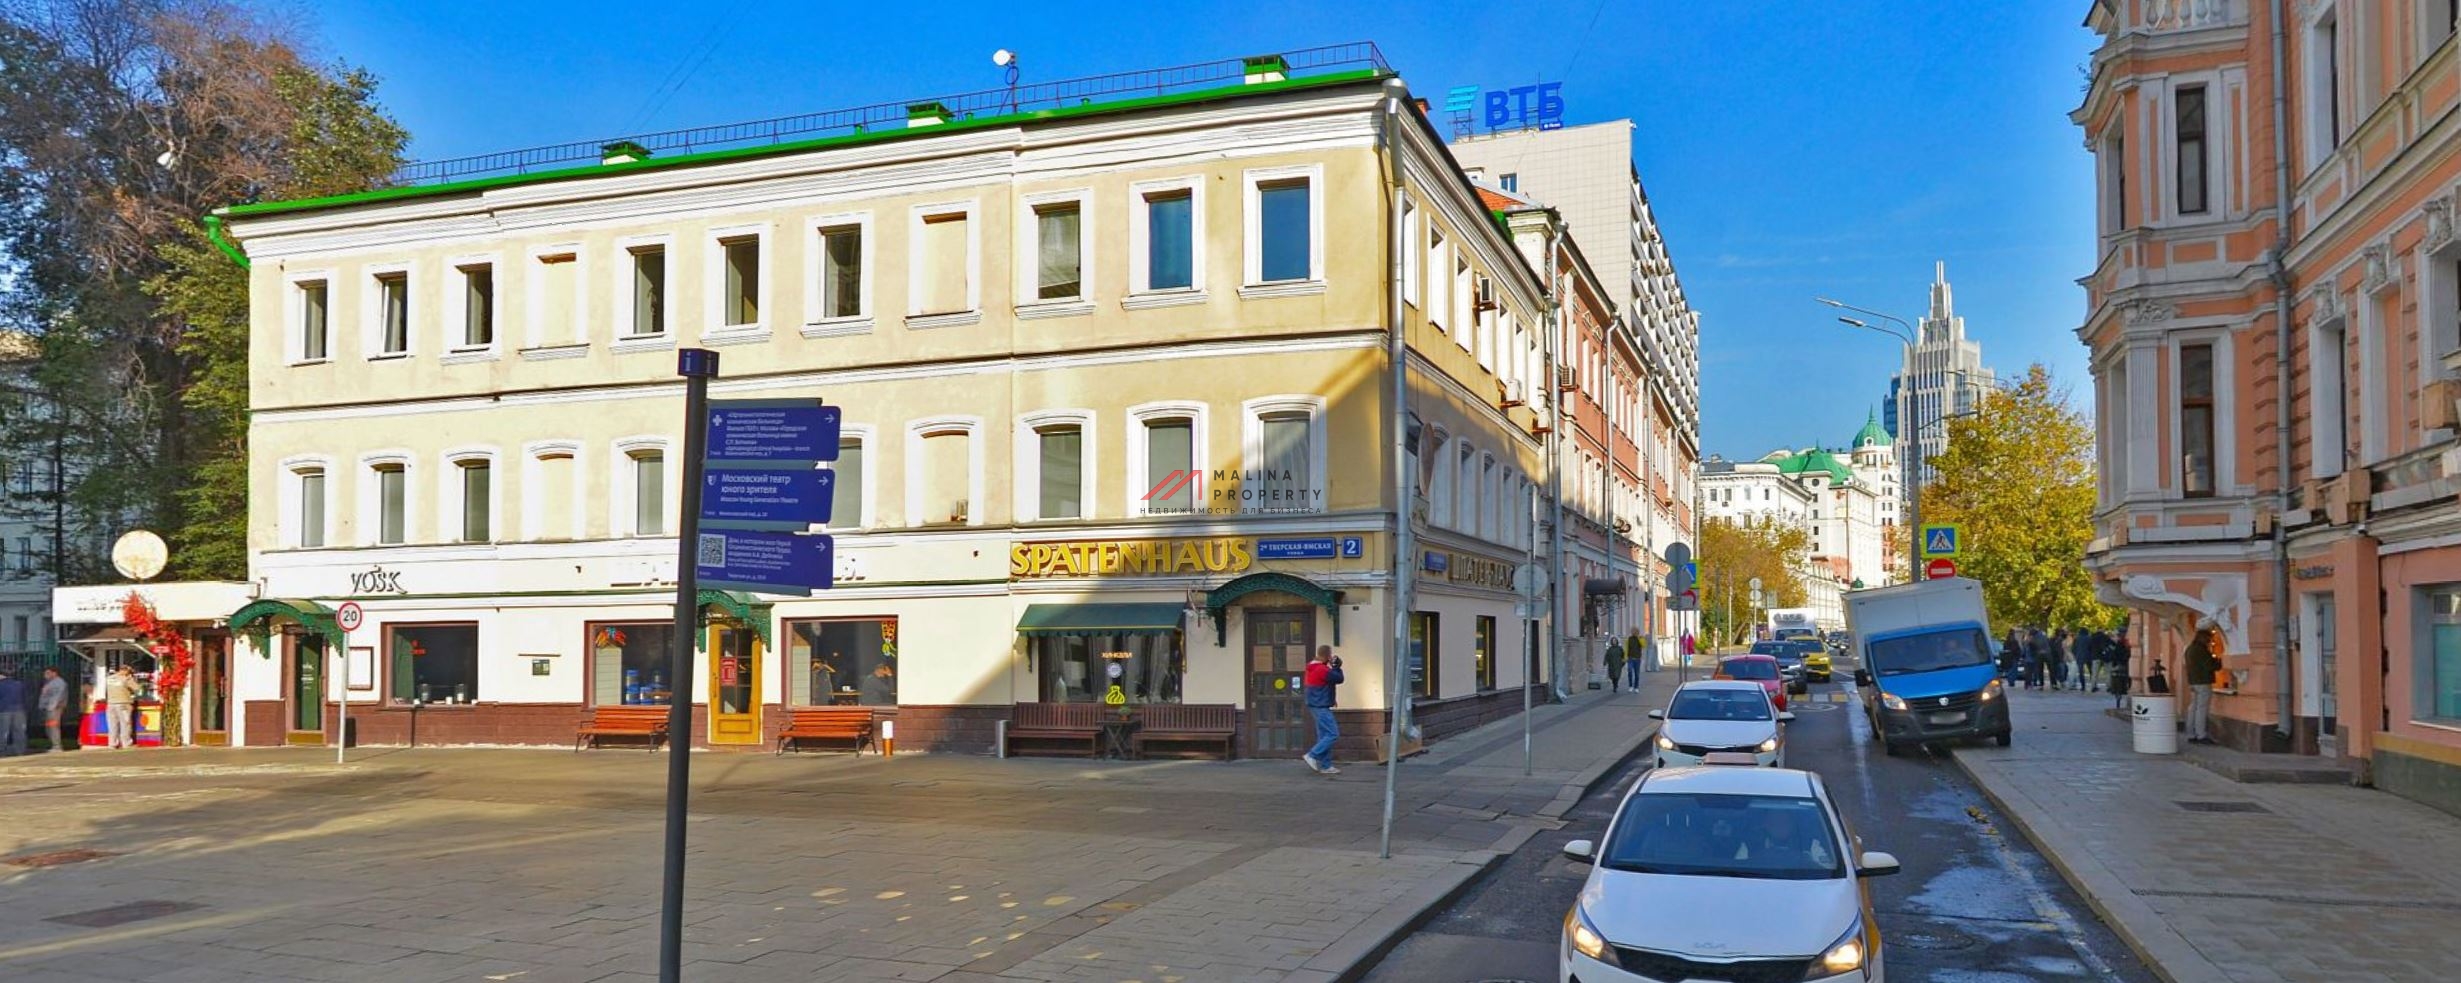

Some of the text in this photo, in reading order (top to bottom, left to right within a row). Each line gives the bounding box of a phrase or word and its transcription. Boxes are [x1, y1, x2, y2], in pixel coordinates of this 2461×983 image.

[1485, 82, 1564, 127] ВТБ
[722, 473, 792, 486] Московский театр
[721, 486, 778, 496] юного зрителя
[1346, 540, 1357, 554] 2
[1011, 538, 1252, 576] SPATENHAUS
[343, 610, 358, 621] 20
